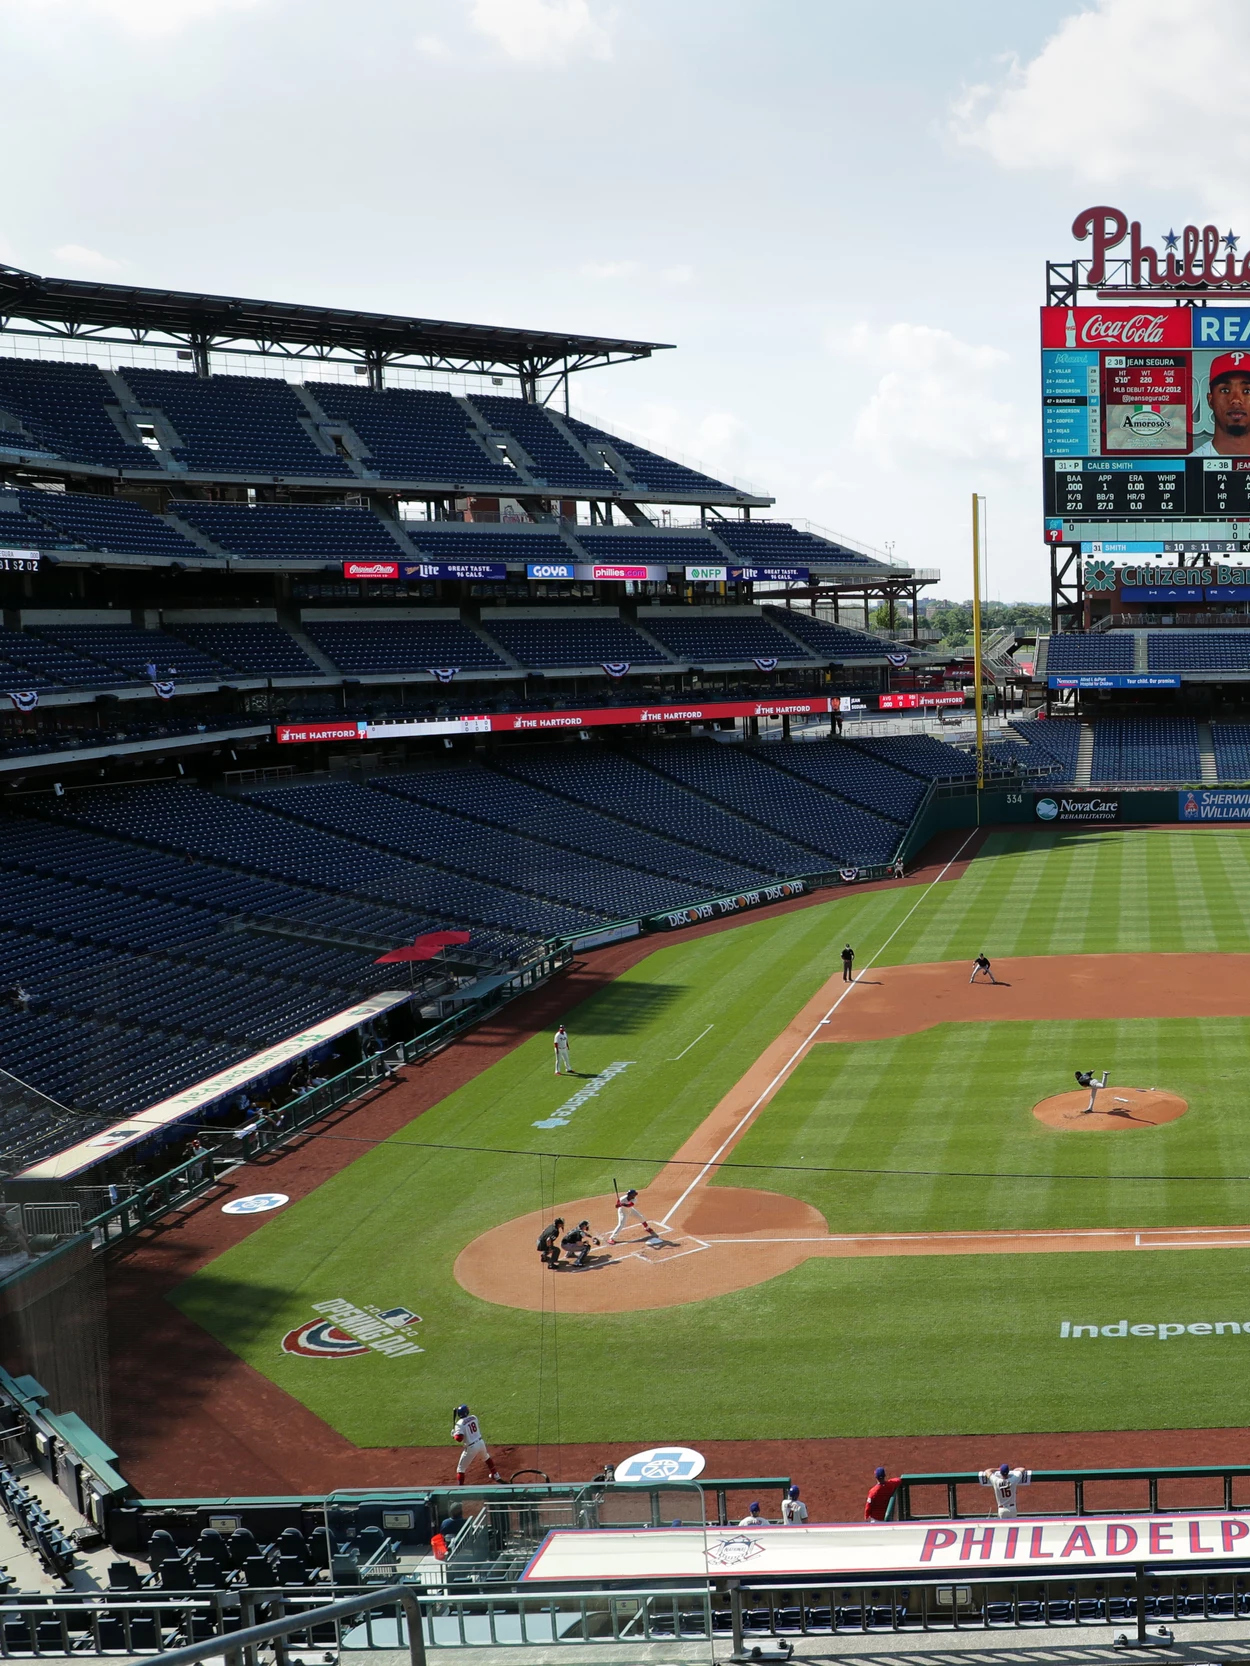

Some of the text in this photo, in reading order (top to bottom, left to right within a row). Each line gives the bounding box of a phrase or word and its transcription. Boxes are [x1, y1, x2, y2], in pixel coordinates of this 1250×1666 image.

[1081, 314, 1169, 343] Coca-Cola
[1126, 358, 1175, 367] JEAN SEGURA
[1139, 376, 1152, 384] 220
[1164, 376, 1174, 384] 30
[1122, 394, 1170, 402] @jeansegura02
[1122, 415, 1172, 429] Amoroso's
[1087, 462, 1133, 470] CALEB SMITH
[1066, 474, 1082, 482] BAA
[1098, 474, 1113, 482] APP
[1128, 474, 1143, 482] ERA
[1157, 474, 1176, 482] WHIP
[1127, 483, 1145, 491] 0.00
[1158, 483, 1176, 491] 3.00
[1174, 543, 1185, 551] 10
[1201, 543, 1210, 551] 11
[1226, 543, 1236, 551] 21
[419, 564, 440, 577] Lite
[533, 566, 568, 577] GOYA
[595, 568, 645, 578] phillies.com
[700, 569, 721, 578] NFP
[742, 567, 759, 579] Lite
[1120, 565, 1213, 586] Citizens
[936, 696, 963, 705] HARTFORD
[761, 705, 811, 715] THE HARTFORD
[648, 711, 702, 721] THE HARTFORD
[521, 717, 582, 728] THE HARTFORD
[289, 729, 355, 741] THE HARTFORD
[1006, 794, 1023, 804] 334
[1059, 799, 1118, 812] NovaCare
[1060, 812, 1116, 820] REHABILITATION
[764, 881, 804, 901] DISCOVER
[717, 891, 761, 913] DISCOVER
[668, 905, 713, 927] DISCOVER
[550, 1061, 637, 1118] Independence
[311, 1298, 426, 1358] OPENING DAY
[467, 1421, 478, 1434] 18
